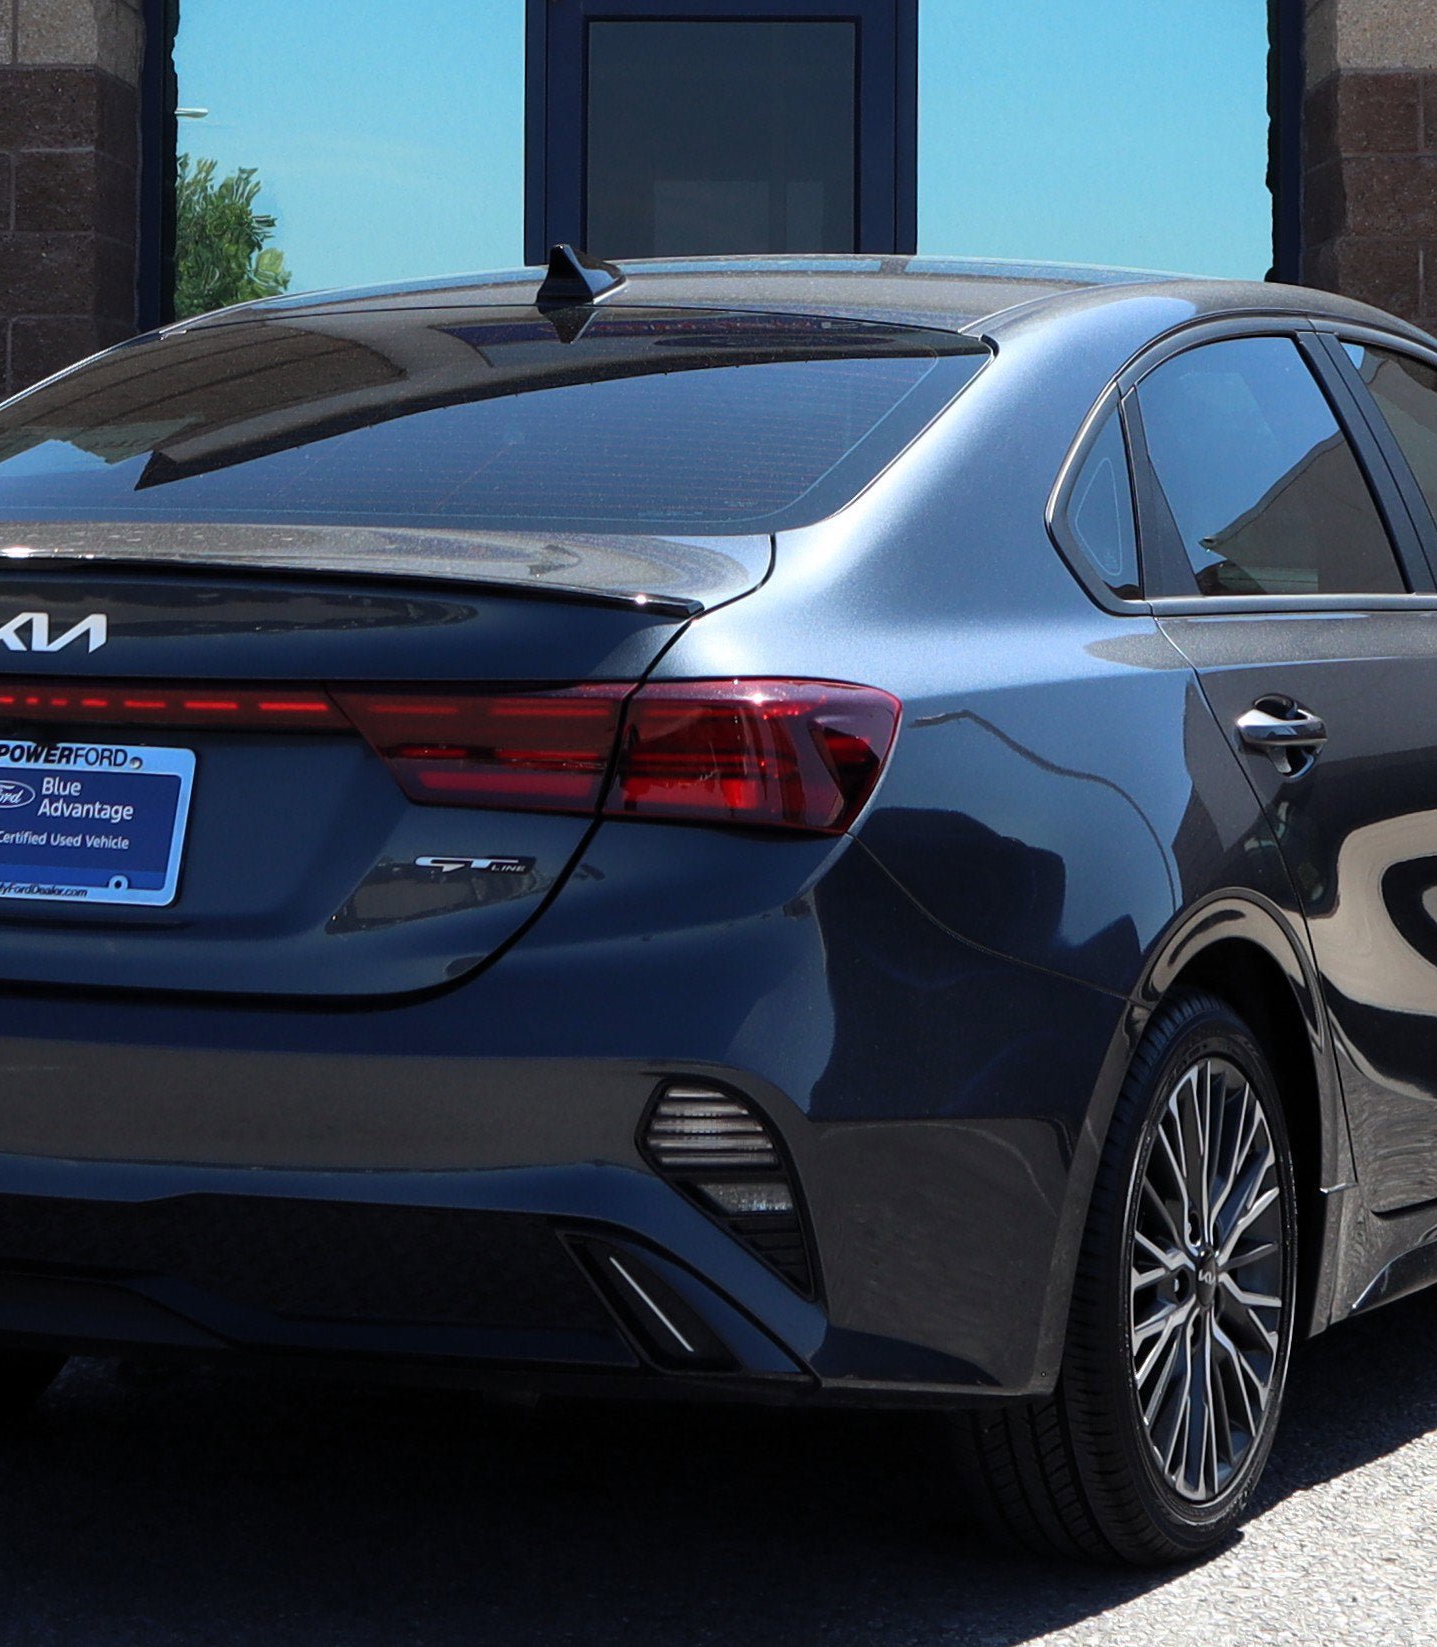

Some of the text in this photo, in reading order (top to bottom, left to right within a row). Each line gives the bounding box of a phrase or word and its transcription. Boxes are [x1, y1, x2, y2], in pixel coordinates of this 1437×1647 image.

[41, 777, 82, 797] Blue
[37, 799, 134, 823] Advantage
[50, 832, 83, 848] Used
[85, 833, 130, 850] Vehicle
[491, 864, 526, 872] LINE
